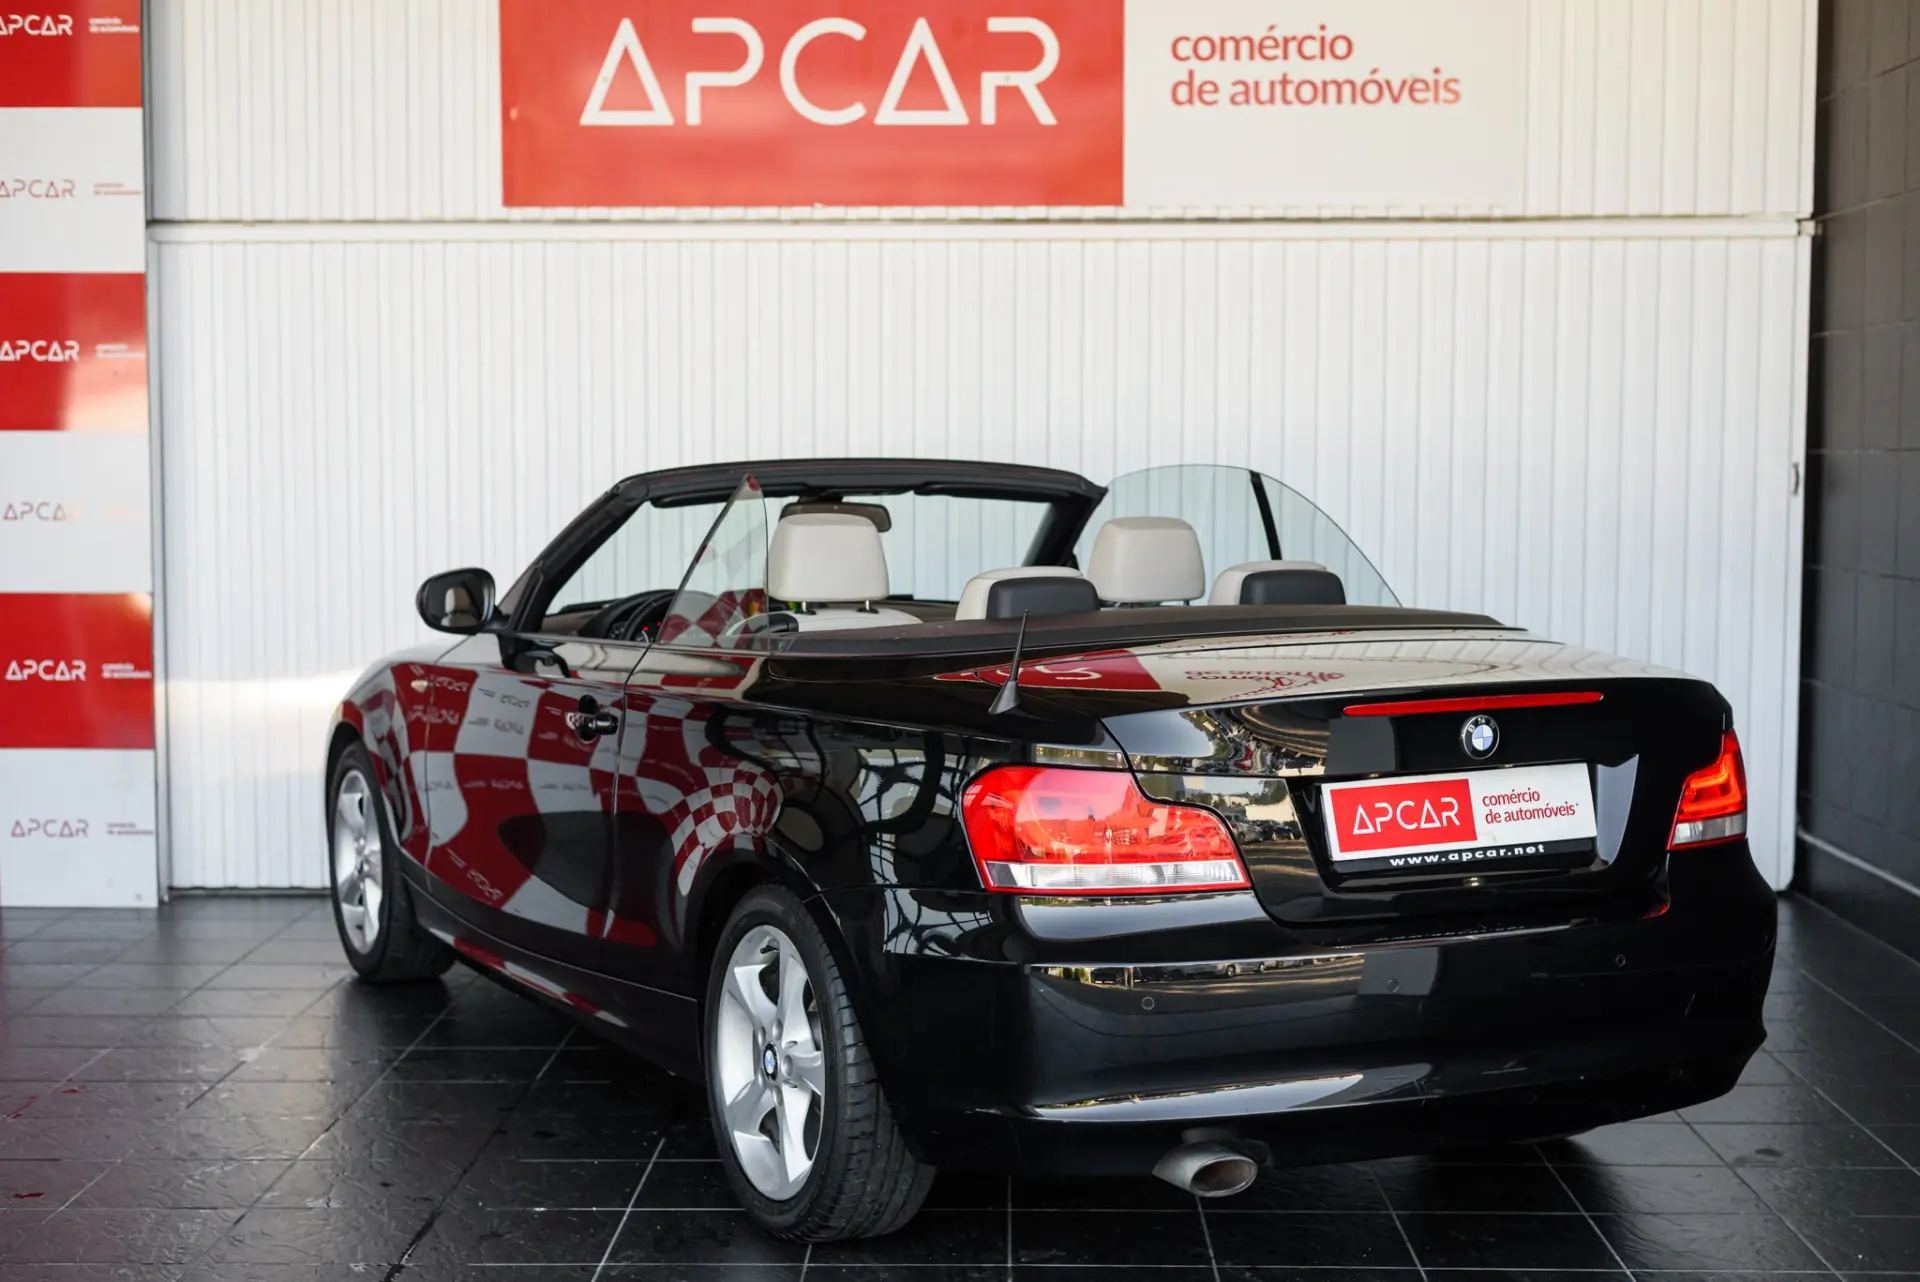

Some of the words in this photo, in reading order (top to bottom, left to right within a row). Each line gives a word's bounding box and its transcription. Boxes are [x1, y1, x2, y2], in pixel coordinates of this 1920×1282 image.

[1170, 23, 1355, 62] comércio
[578, 17, 1061, 128] APCAR
[1170, 68, 1220, 106] de
[1229, 67, 1462, 106] automóveis
[0, 339, 80, 362] APCAR
[5, 659, 87, 681] APCAR
[1482, 787, 1541, 808] comércio
[1353, 797, 1461, 835] APCAR
[1485, 808, 1502, 825] de
[1504, 801, 1576, 823] automóveis
[11, 818, 89, 838] APCAR
[1389, 843, 1545, 867] www.apcar.net
